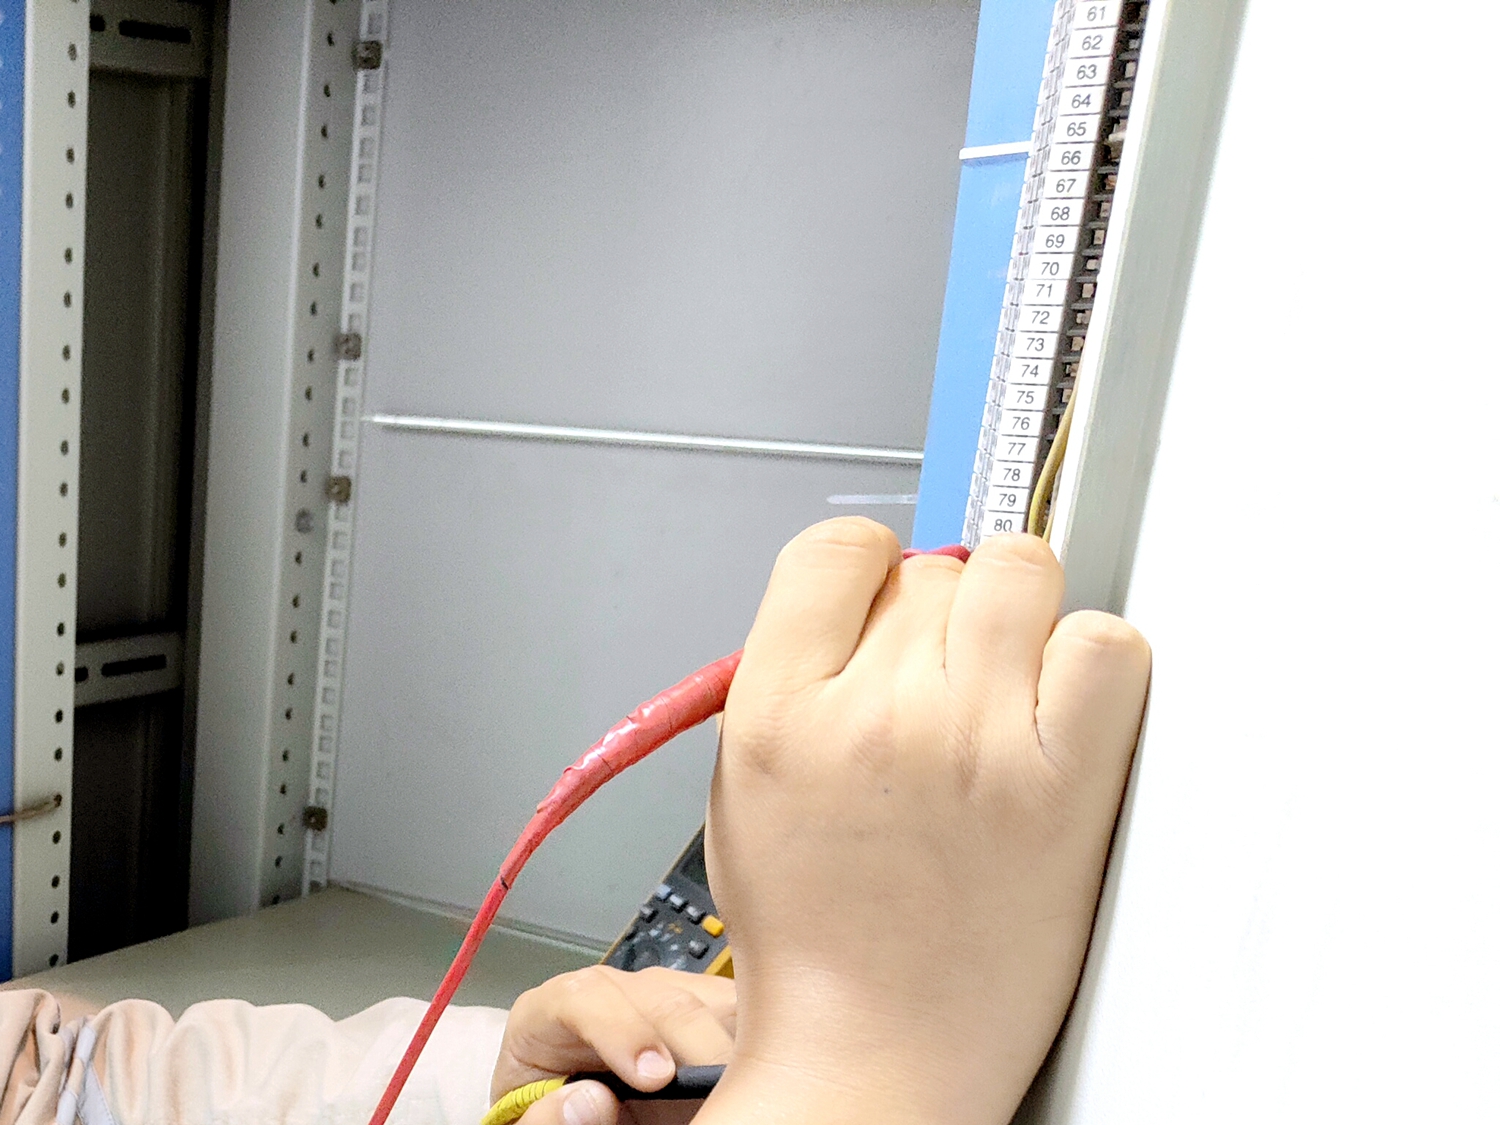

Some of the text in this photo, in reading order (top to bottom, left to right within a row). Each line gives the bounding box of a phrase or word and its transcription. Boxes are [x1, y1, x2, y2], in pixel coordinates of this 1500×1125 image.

[1087, 6, 1106, 21] 61
[1082, 35, 1103, 51] 62
[1077, 64, 1097, 80] 63
[1072, 94, 1092, 108] 64
[1067, 122, 1087, 137] 65
[1061, 150, 1081, 165] 66
[1056, 178, 1076, 193] 67
[1051, 206, 1071, 220] 68
[1045, 234, 1065, 248] 69
[1041, 261, 1060, 275] 70
[1036, 284, 1053, 297] 71
[1031, 311, 1050, 324] 72
[1026, 338, 1045, 352] 73
[1021, 364, 1039, 378] 74
[1016, 390, 1035, 404] 75
[1012, 416, 1031, 430] 76
[1008, 442, 1027, 456] 77
[1003, 468, 1021, 482] 78
[999, 494, 1017, 507] 79
[994, 518, 1012, 533] 80
